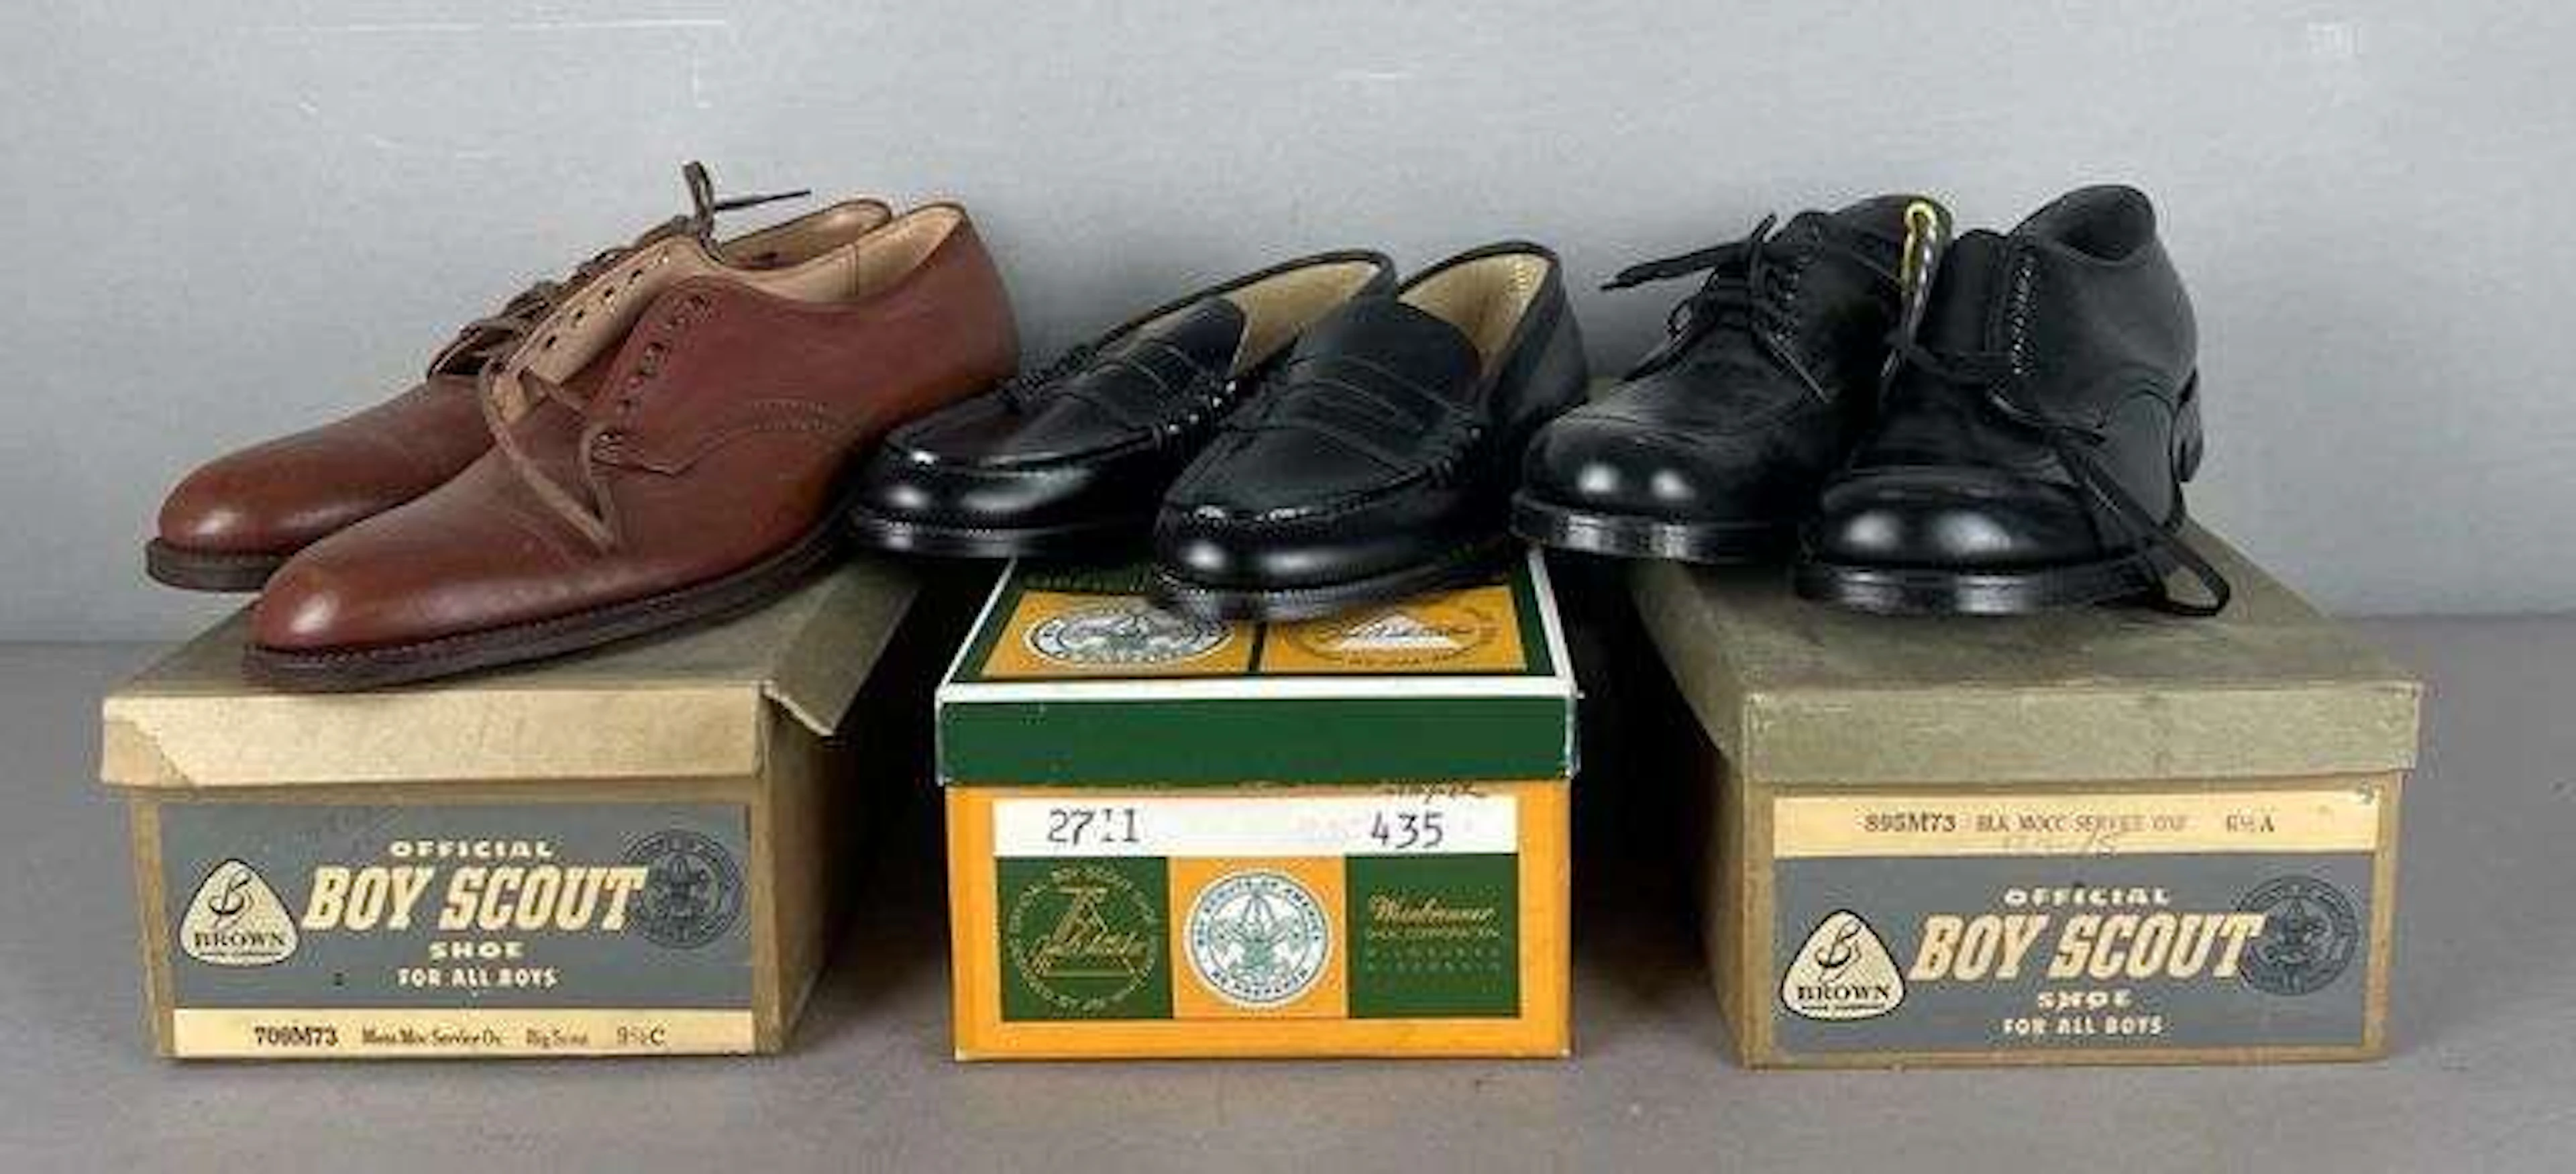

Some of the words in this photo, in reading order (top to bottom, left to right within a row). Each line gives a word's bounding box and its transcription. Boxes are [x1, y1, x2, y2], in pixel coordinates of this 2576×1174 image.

[1371, 810, 1444, 849] 435
[389, 839, 554, 859] OFFICIAL
[300, 863, 437, 932] BOY
[436, 863, 649, 932] SCOUT
[2003, 887, 2172, 906] OFFICIAL
[192, 930, 286, 949] BROWN
[427, 940, 526, 960] SHOE
[1907, 913, 2050, 982] BOY
[2047, 912, 2268, 980] SCOUT
[396, 967, 441, 988] FOR
[451, 967, 490, 988] ALL
[498, 966, 559, 988] BOYS
[1797, 985, 1892, 1000] BROWN
[2037, 989, 2133, 1011] SHOE
[2004, 1017, 2046, 1036] FOR
[2056, 1016, 2096, 1035] ALL
[2104, 1014, 2163, 1036] BOYS
